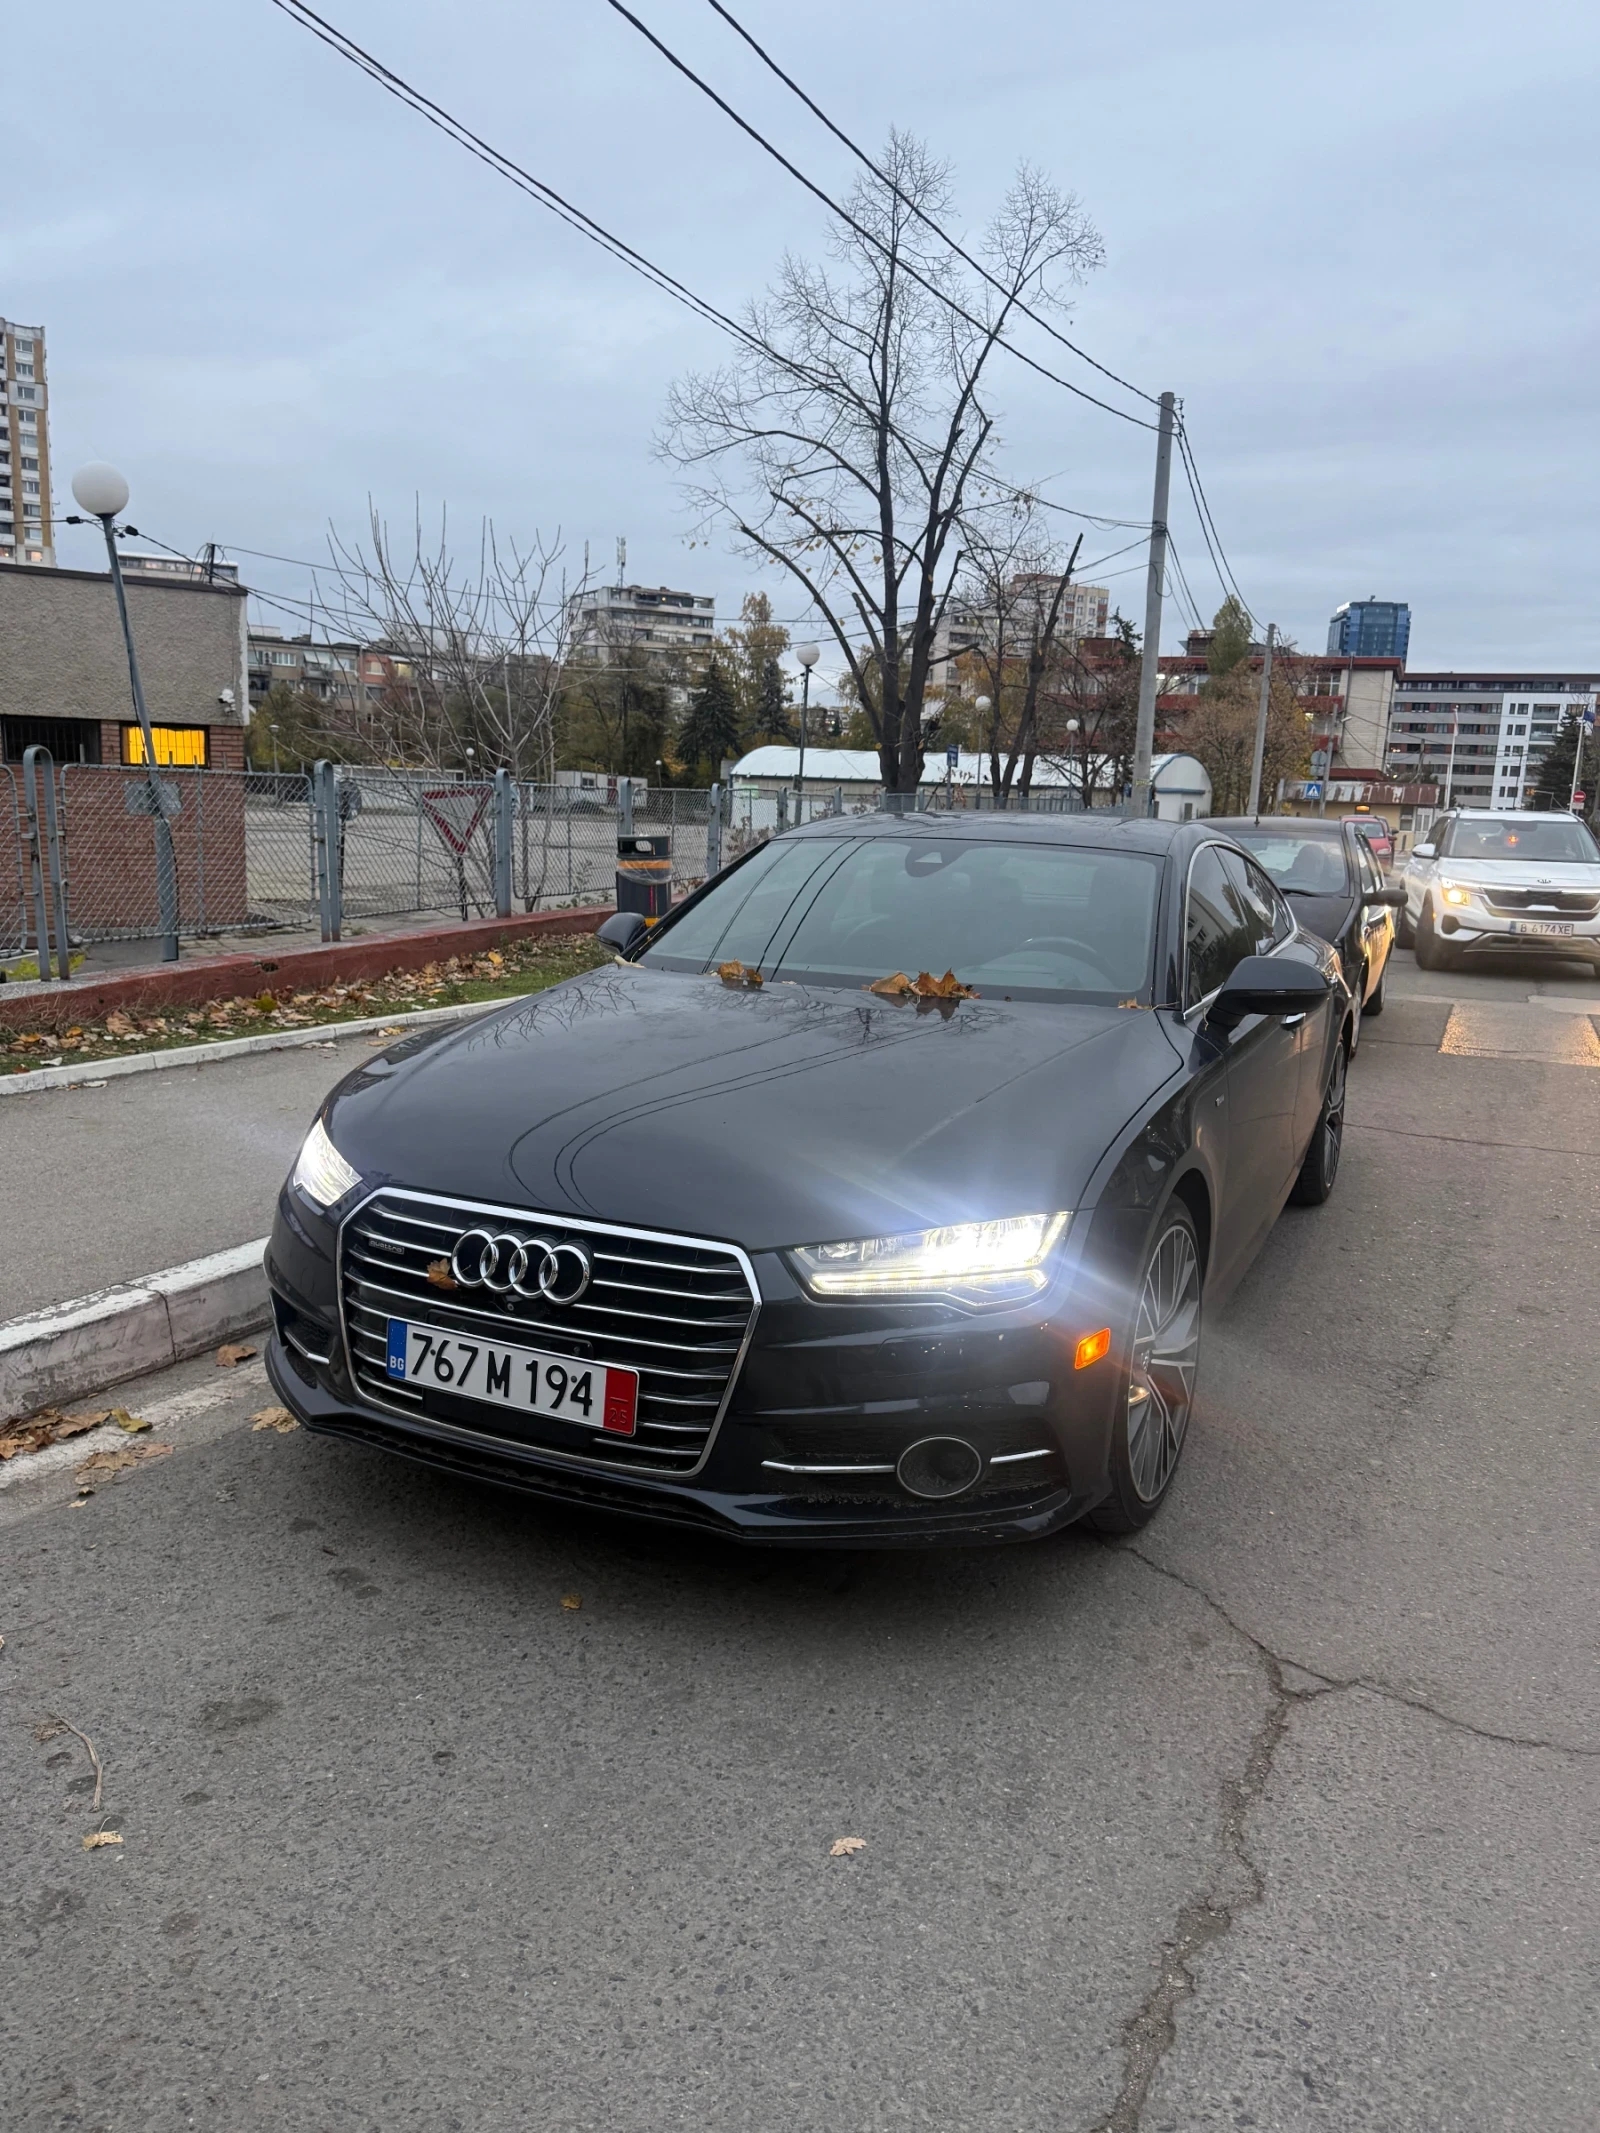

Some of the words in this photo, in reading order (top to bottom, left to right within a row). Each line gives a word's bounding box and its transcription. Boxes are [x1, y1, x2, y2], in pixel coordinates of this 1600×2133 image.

[1531, 924, 1556, 934] 6174
[1557, 925, 1571, 935] XE
[390, 1355, 404, 1371] BG
[411, 1332, 479, 1387] 767
[486, 1350, 512, 1398] M
[525, 1360, 593, 1416] 194
[608, 1407, 628, 1424] 25
